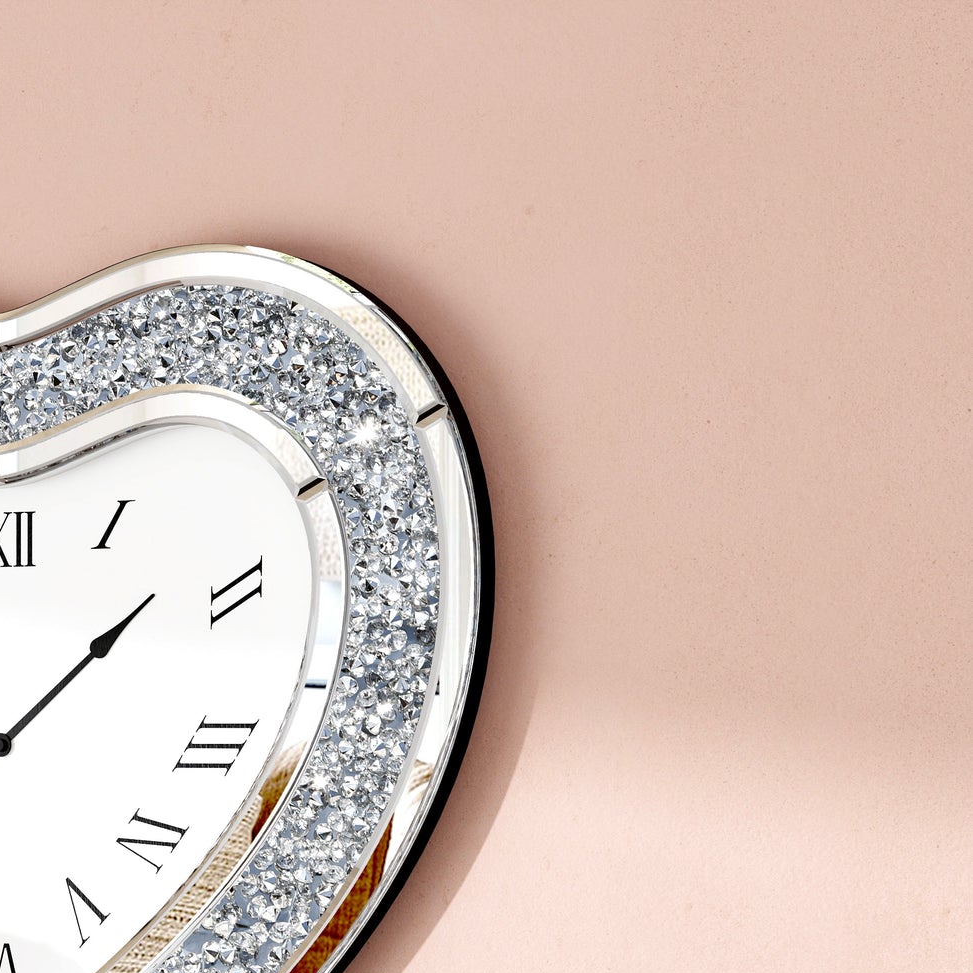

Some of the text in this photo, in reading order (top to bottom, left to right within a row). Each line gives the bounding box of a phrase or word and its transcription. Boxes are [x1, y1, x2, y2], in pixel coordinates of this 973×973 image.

[91, 499, 135, 550] I
[210, 554, 263, 630] II
[172, 714, 260, 777] III
[115, 807, 191, 875] IV
[65, 877, 111, 949] V
